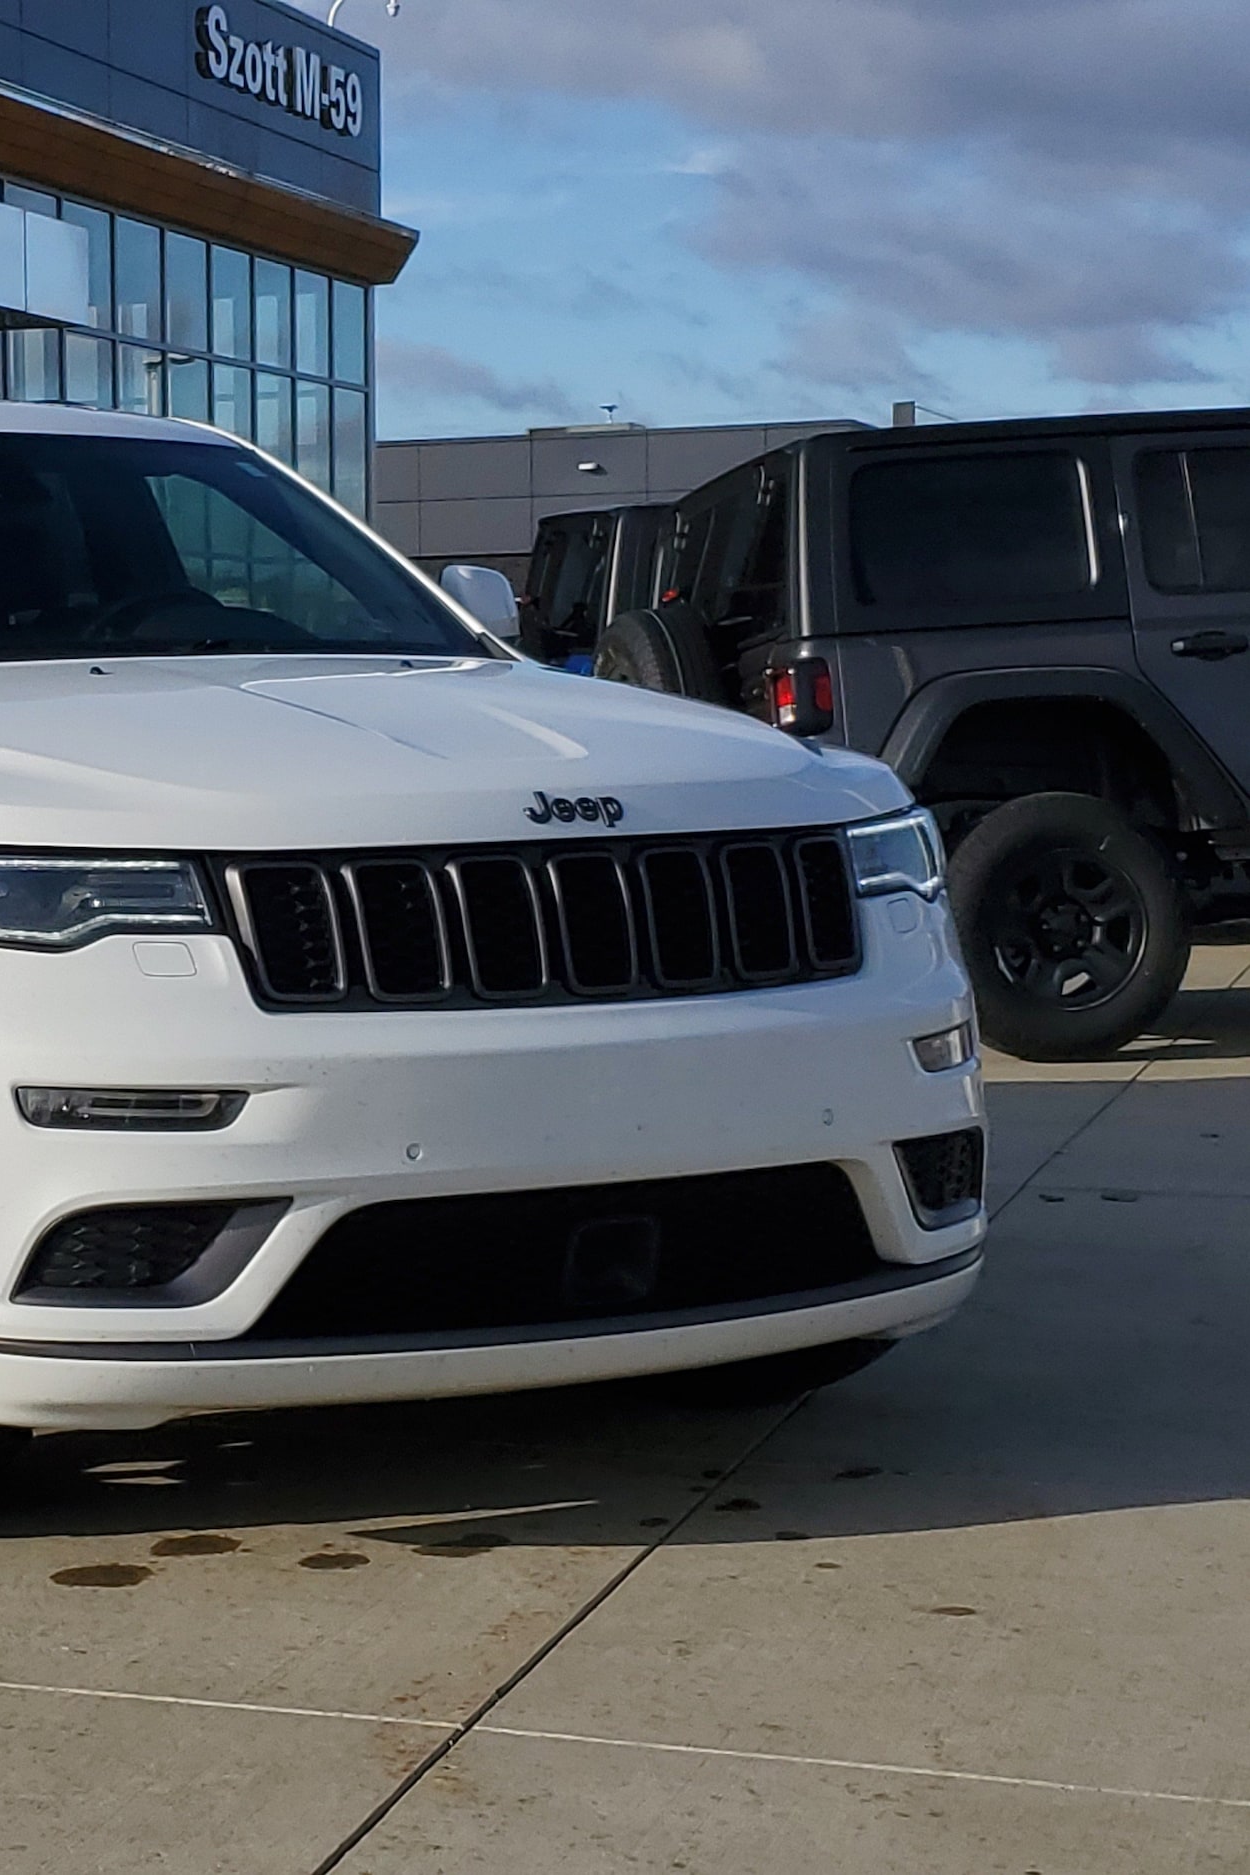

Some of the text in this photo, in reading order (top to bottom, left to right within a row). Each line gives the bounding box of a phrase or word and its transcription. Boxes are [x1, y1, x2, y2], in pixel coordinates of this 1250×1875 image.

[197, 5, 362, 137] Szott M-59
[523, 791, 624, 828] Jeep
